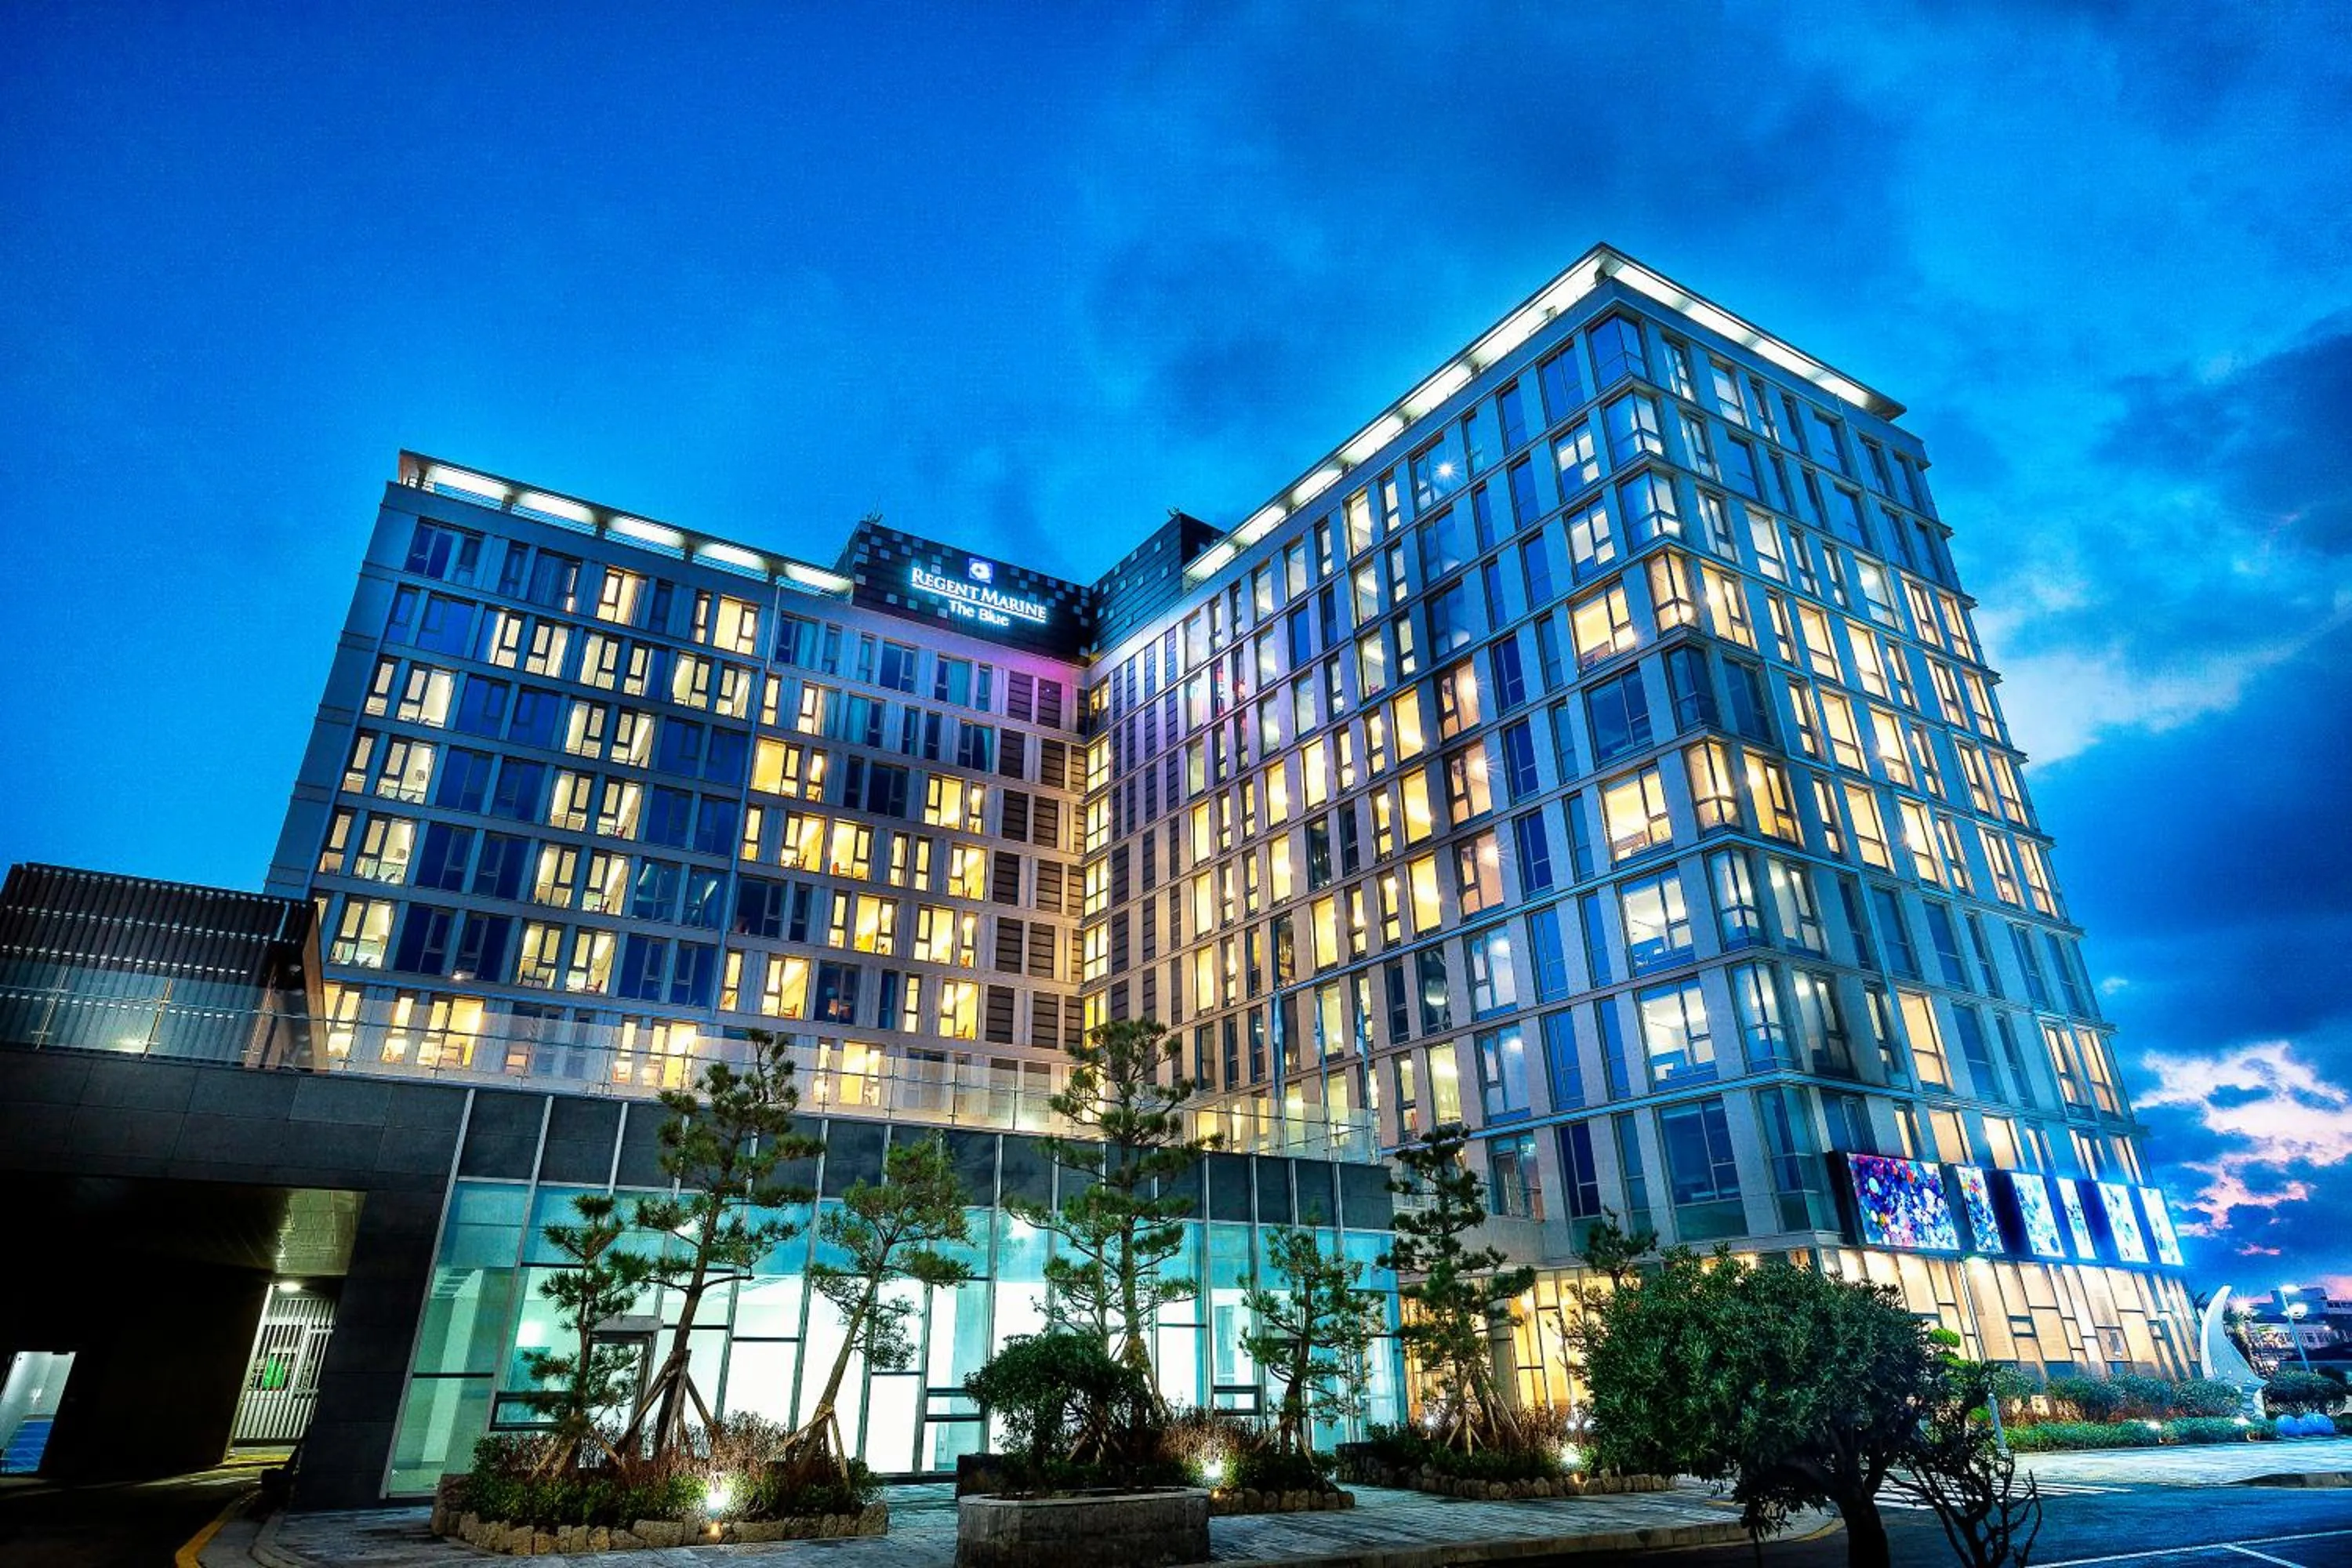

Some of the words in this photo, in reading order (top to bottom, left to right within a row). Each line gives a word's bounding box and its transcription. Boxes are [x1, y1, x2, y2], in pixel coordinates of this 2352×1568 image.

[912, 567, 979, 600] REGENT
[980, 587, 1047, 619] MARINE
[949, 600, 975, 617] The
[978, 608, 1010, 626] Blue
